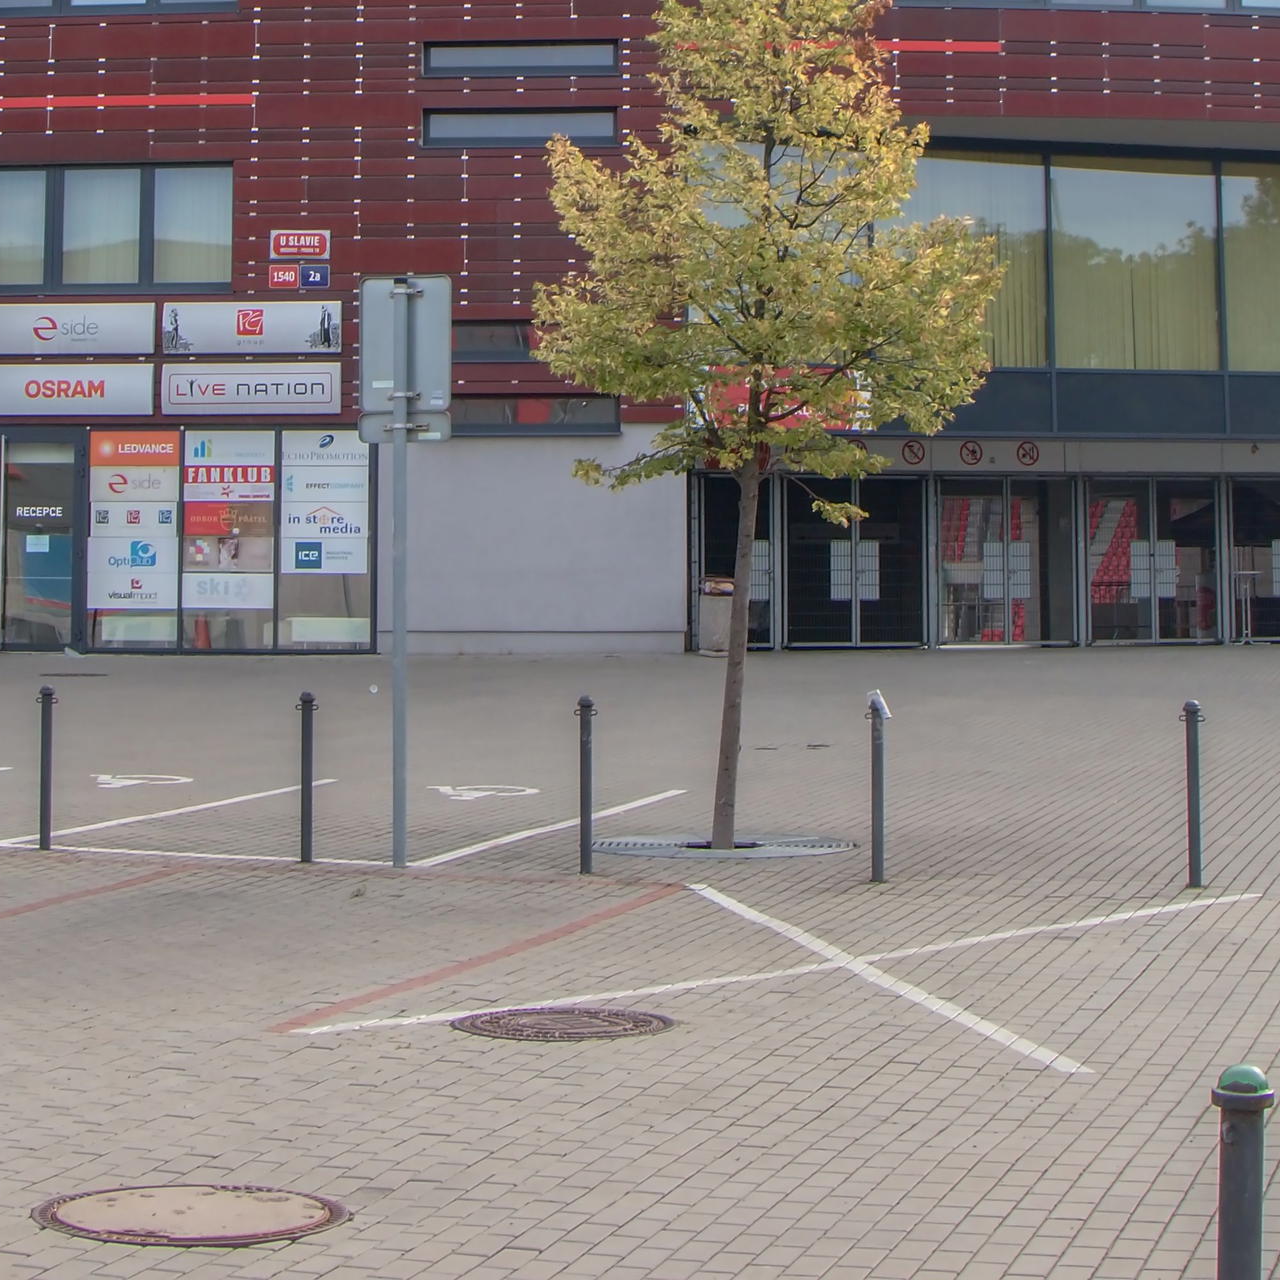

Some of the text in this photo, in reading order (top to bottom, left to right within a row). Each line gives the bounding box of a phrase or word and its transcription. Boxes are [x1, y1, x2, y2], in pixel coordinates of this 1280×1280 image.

[280, 235, 320, 246] U SLAVIE
[273, 271, 295, 282] 1540
[308, 270, 321, 281] 2a
[24, 379, 106, 399] OSRAM
[176, 380, 325, 397] LIVE NATION
[118, 443, 174, 454] LEDVANCE
[187, 467, 271, 483] FANKLUB
[16, 507, 64, 517] RECEPCE
[288, 513, 301, 525] in
[320, 523, 361, 534] media
